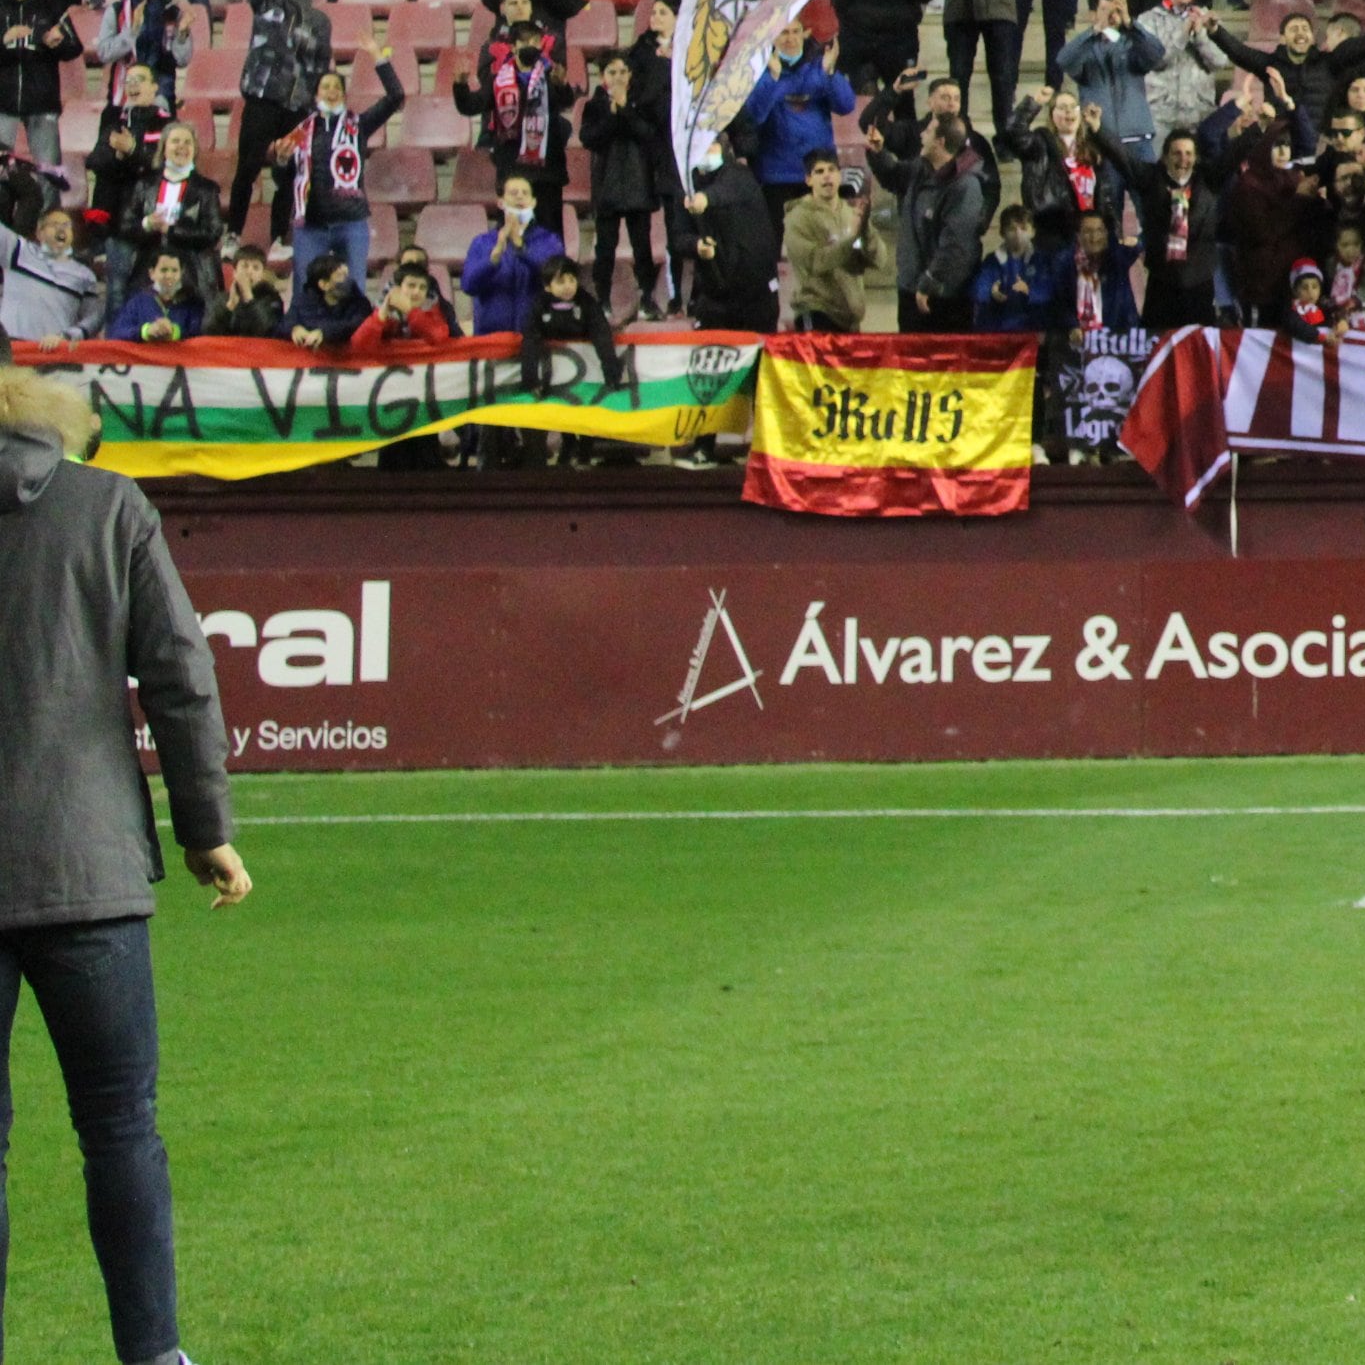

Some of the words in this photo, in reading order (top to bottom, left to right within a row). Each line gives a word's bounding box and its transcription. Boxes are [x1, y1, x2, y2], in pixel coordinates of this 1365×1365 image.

[779, 601, 1052, 686] Álvarez
[1074, 615, 1132, 681] &
[232, 727, 251, 757] y
[257, 719, 388, 751] Servicios
